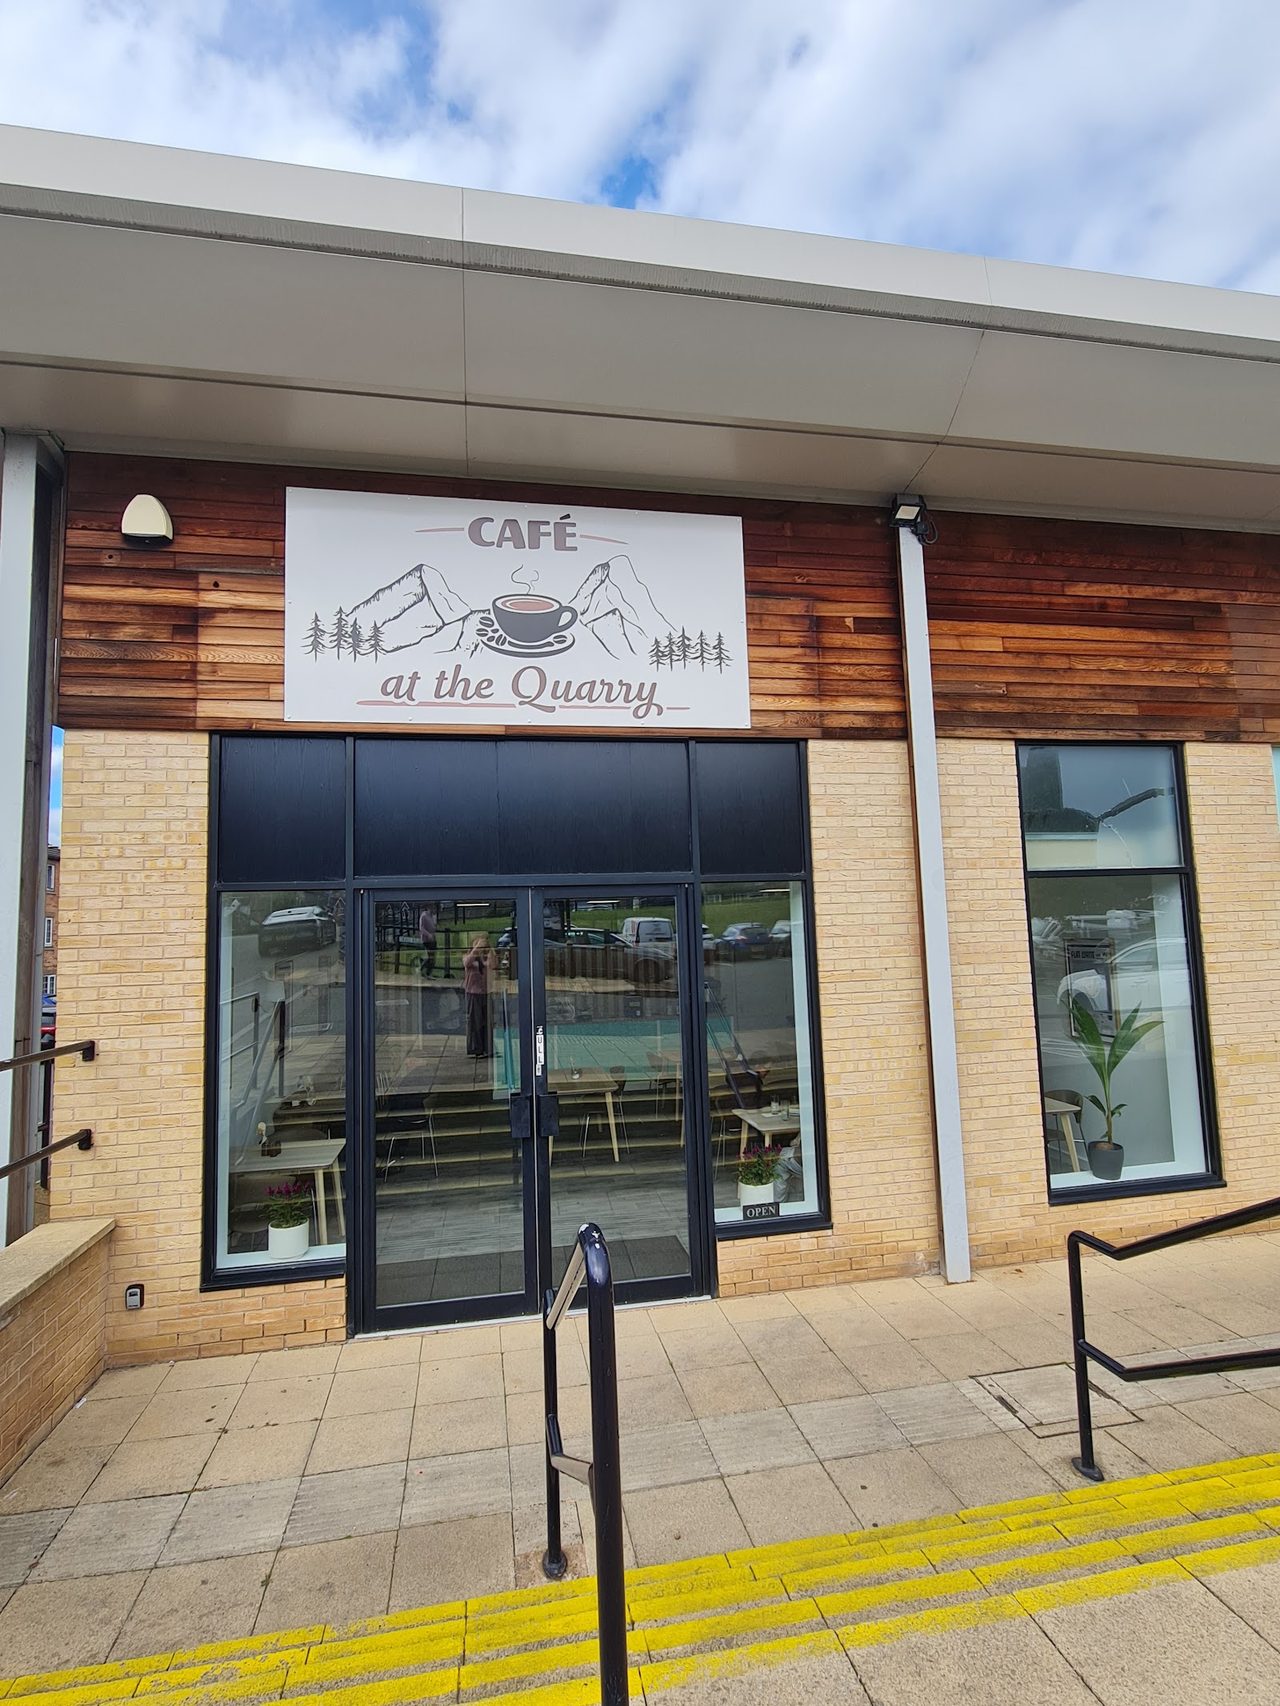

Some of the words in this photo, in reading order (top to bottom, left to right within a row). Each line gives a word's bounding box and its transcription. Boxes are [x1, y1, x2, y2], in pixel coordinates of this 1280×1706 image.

[468, 513, 579, 552] CAFÉ
[380, 670, 421, 701] at
[433, 664, 495, 701] the
[511, 665, 663, 719] Quarry
[746, 1205, 776, 1218] OPEN
